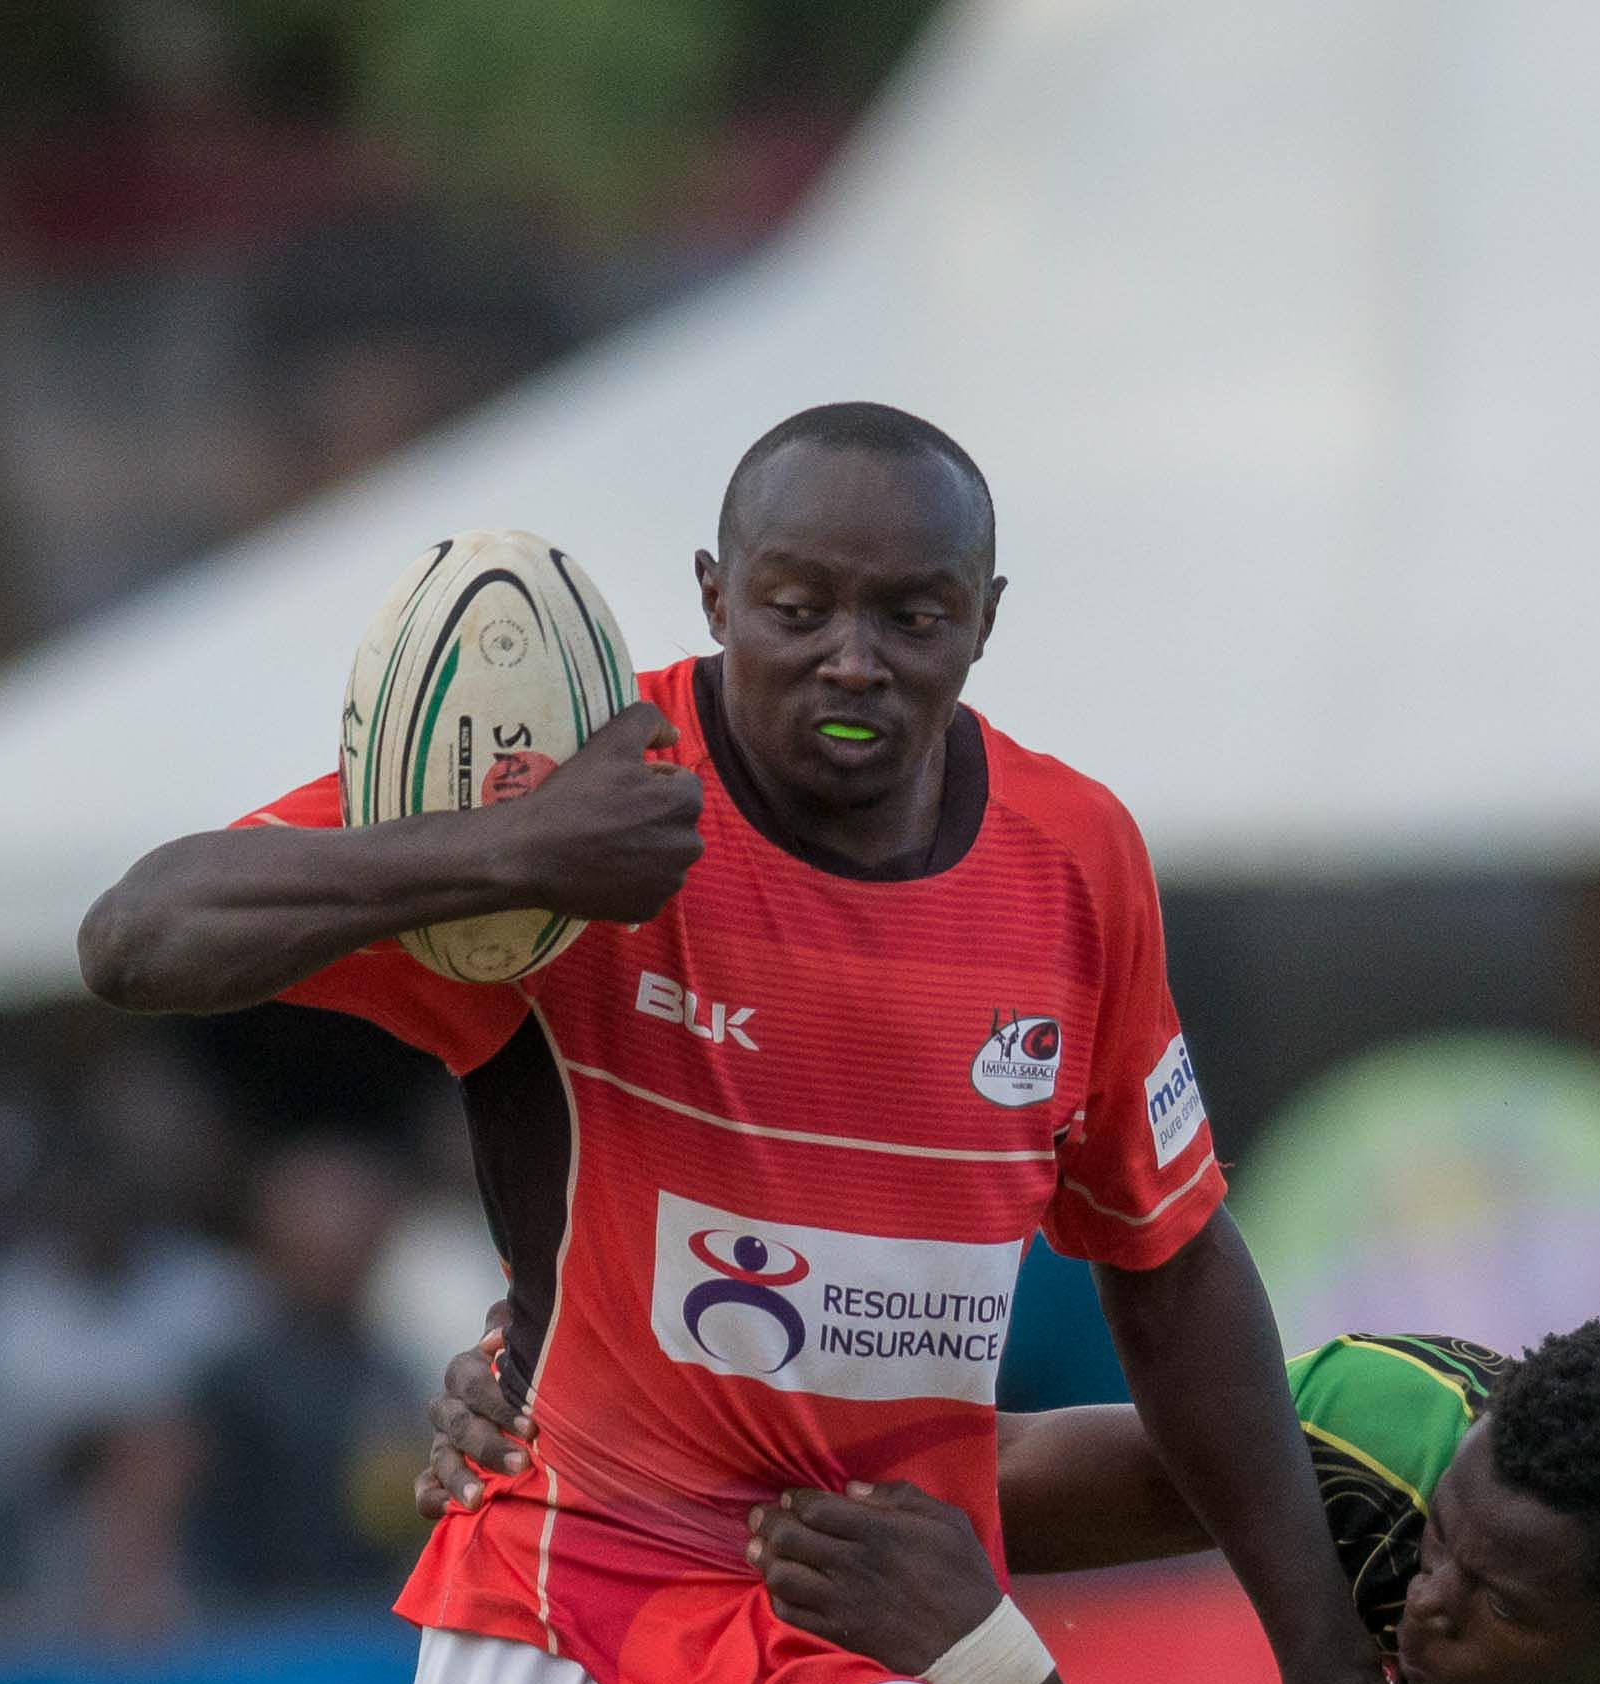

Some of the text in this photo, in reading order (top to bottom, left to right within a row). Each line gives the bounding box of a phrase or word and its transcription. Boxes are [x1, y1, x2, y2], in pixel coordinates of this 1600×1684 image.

[635, 970, 760, 1051] BLK
[823, 1283, 1009, 1324] RESOLUTION
[820, 1323, 999, 1362] INSURANCE
